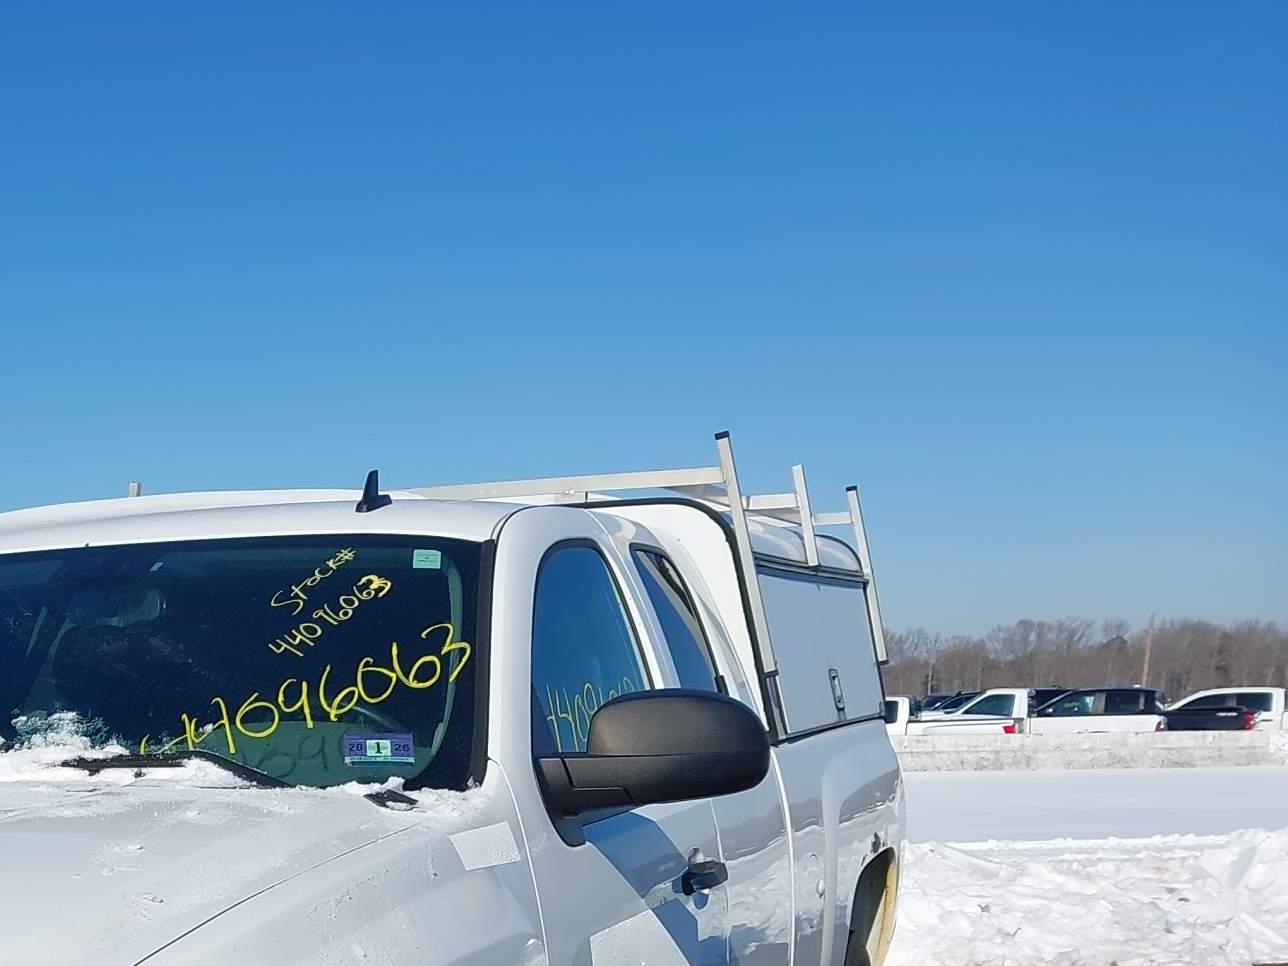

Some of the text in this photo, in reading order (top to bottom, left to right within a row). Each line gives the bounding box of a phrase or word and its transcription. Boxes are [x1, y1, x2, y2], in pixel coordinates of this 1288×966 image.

[268, 575, 392, 656] 44096063
[348, 743, 363, 752] 20
[374, 741, 383, 754] 1
